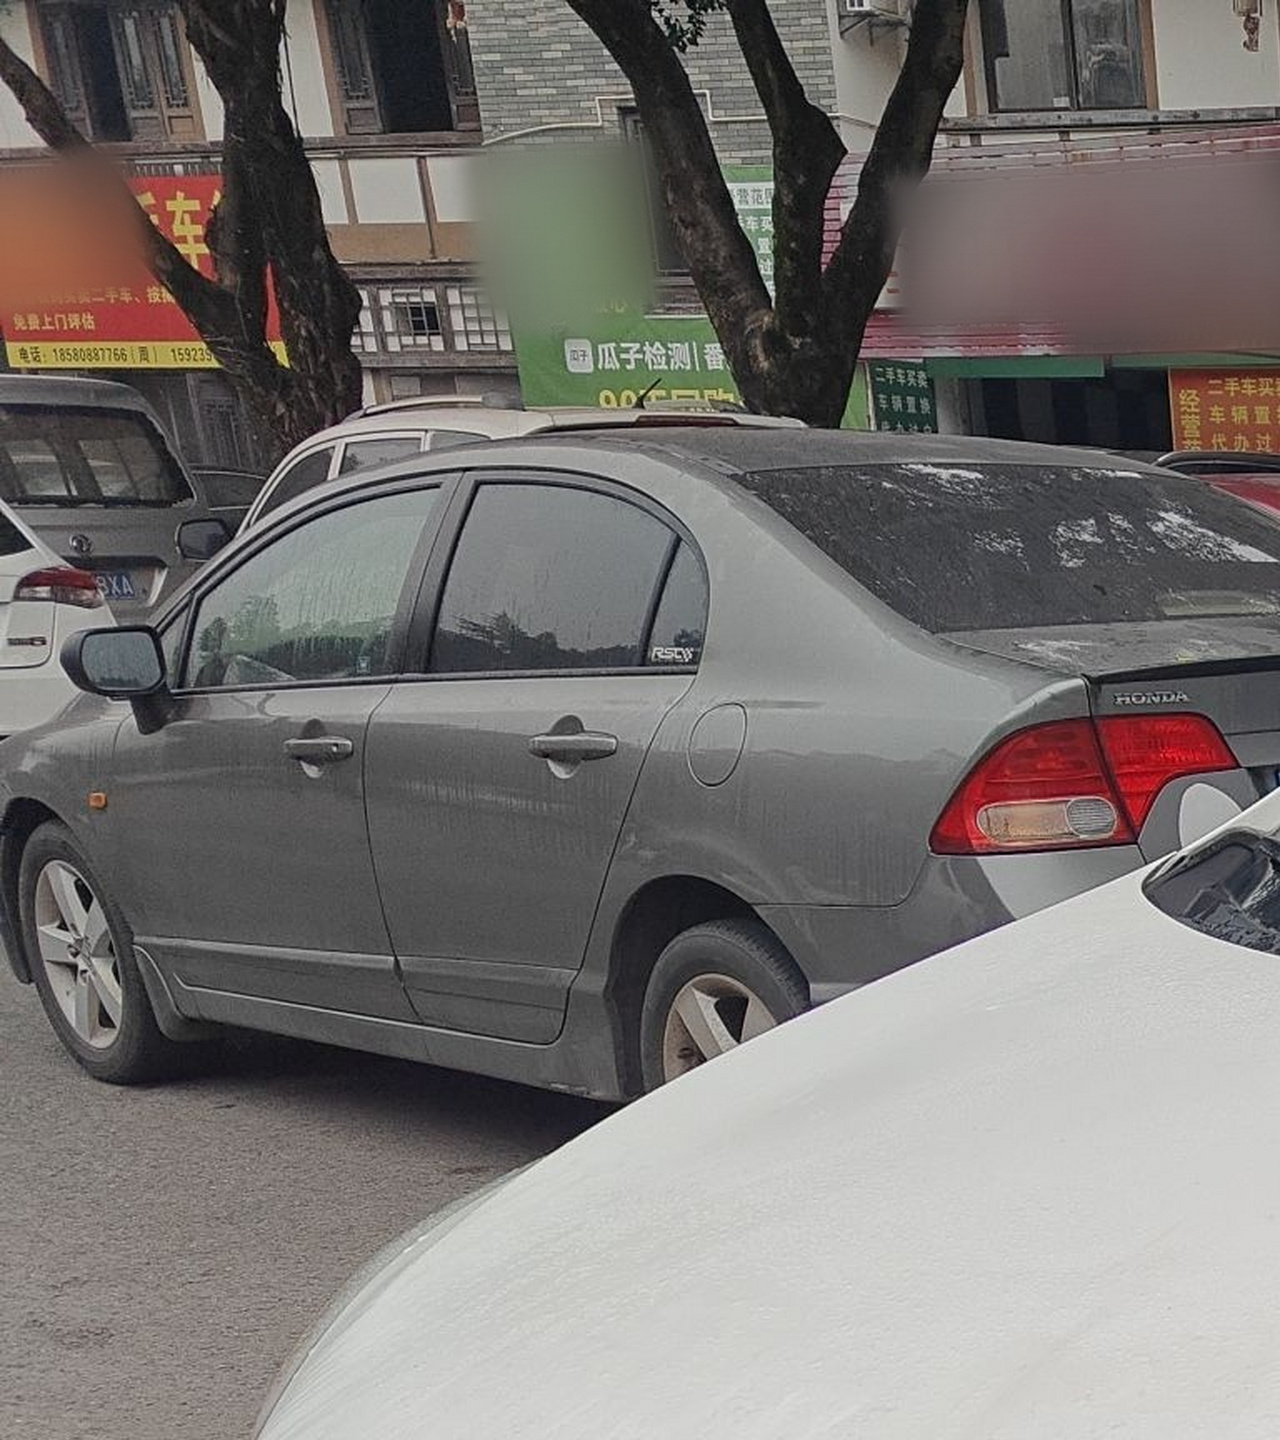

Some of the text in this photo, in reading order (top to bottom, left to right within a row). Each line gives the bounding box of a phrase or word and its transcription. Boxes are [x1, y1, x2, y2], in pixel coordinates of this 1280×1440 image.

[13, 312, 95, 332] 免费上门评估
[1113, 690, 1189, 706] HONDA
